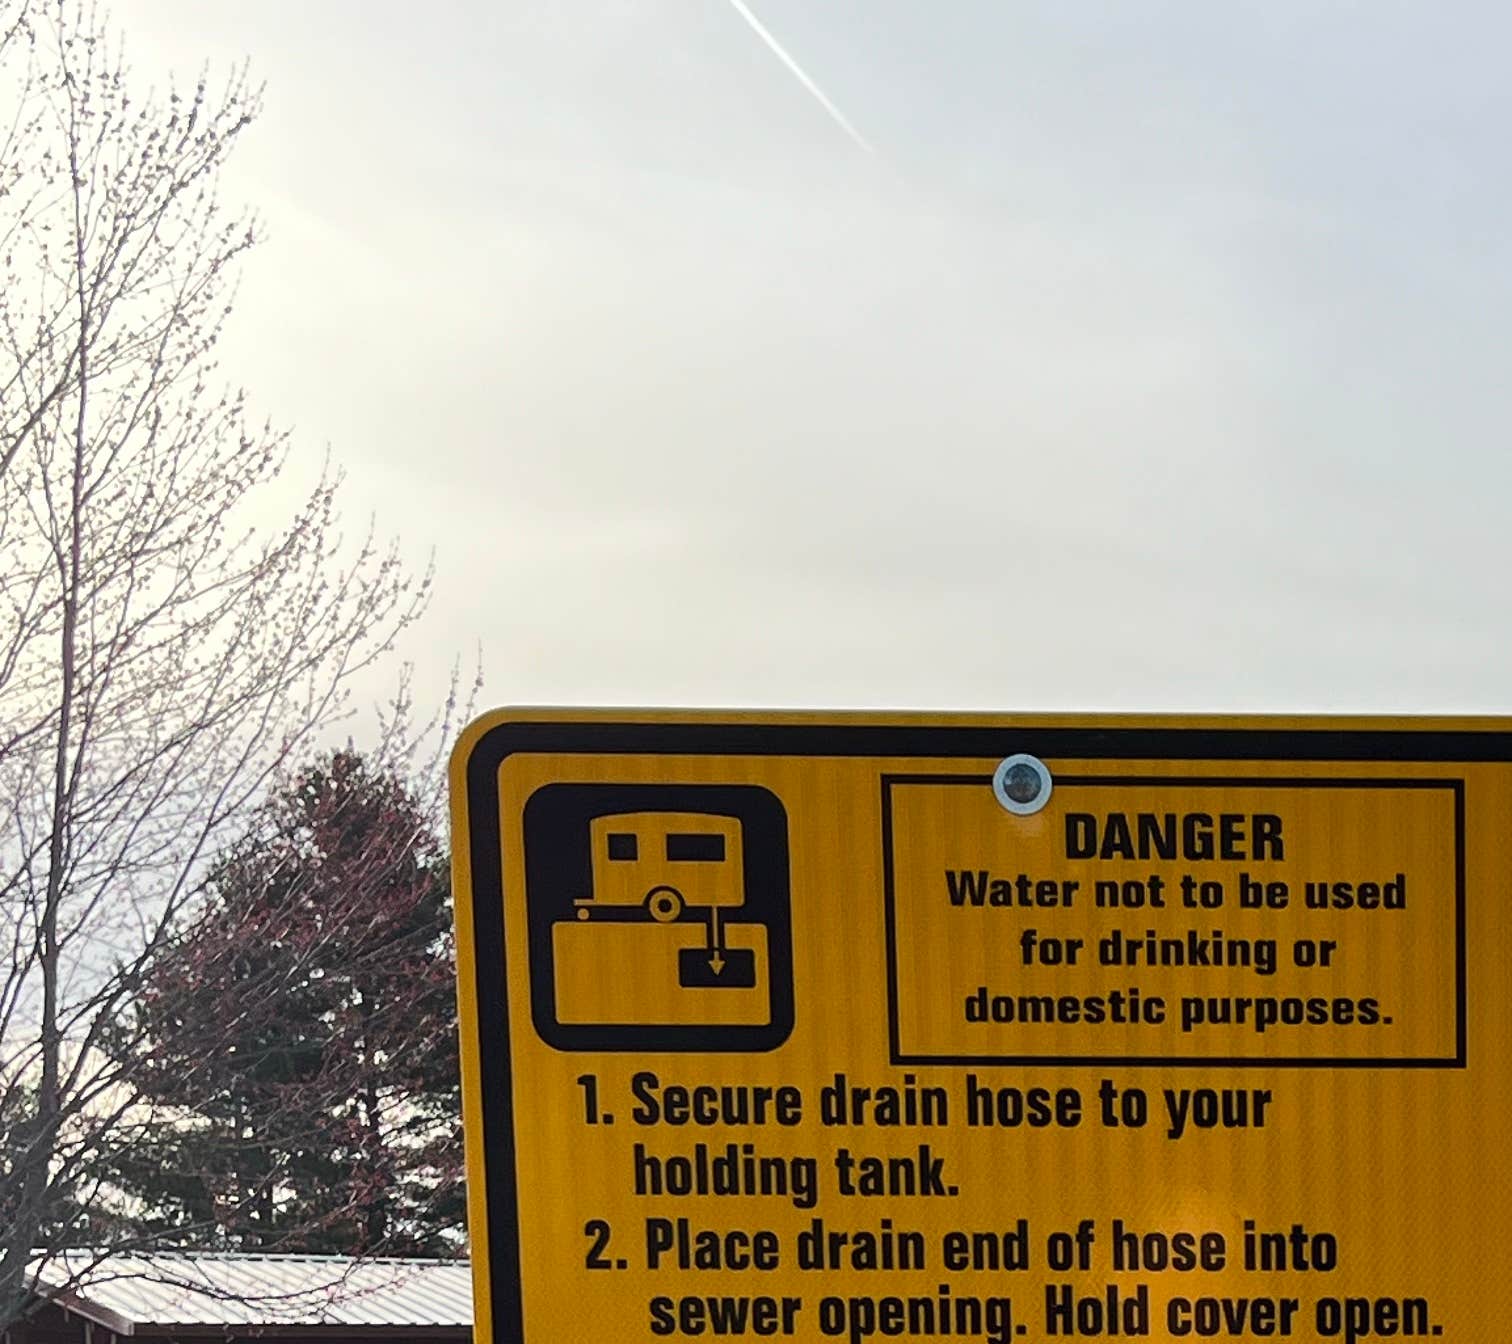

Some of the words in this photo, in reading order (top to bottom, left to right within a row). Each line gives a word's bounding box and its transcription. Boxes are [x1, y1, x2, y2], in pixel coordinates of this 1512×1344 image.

[1064, 811, 1285, 862] DANGER
[944, 869, 1081, 908] Water
[1094, 874, 1166, 909] not
[1179, 874, 1224, 909] to
[1238, 871, 1289, 910] be
[1304, 872, 1407, 911] used
[1019, 928, 1084, 966] for
[1098, 928, 1278, 977] drinking
[1292, 939, 1338, 968] or
[964, 986, 1166, 1025] domestic
[1180, 996, 1396, 1034] purposes.
[576, 1074, 615, 1126] 1.
[631, 1071, 803, 1127] Secure
[819, 1072, 949, 1127] drain
[965, 1073, 1082, 1128] hose
[1097, 1078, 1148, 1129] to
[1162, 1087, 1273, 1141] your
[633, 1142, 818, 1210] holding
[834, 1143, 960, 1197] tank.
[583, 1219, 628, 1270] 2.
[645, 1217, 780, 1271] Place
[796, 1217, 925, 1271] drain
[942, 1218, 1030, 1272] end
[1046, 1219, 1096, 1272] of
[1111, 1219, 1226, 1272] hose
[1243, 1219, 1338, 1273] into
[648, 1295, 802, 1337] sewer
[1044, 1283, 1149, 1337] Hold
[1166, 1297, 1300, 1337] cover
